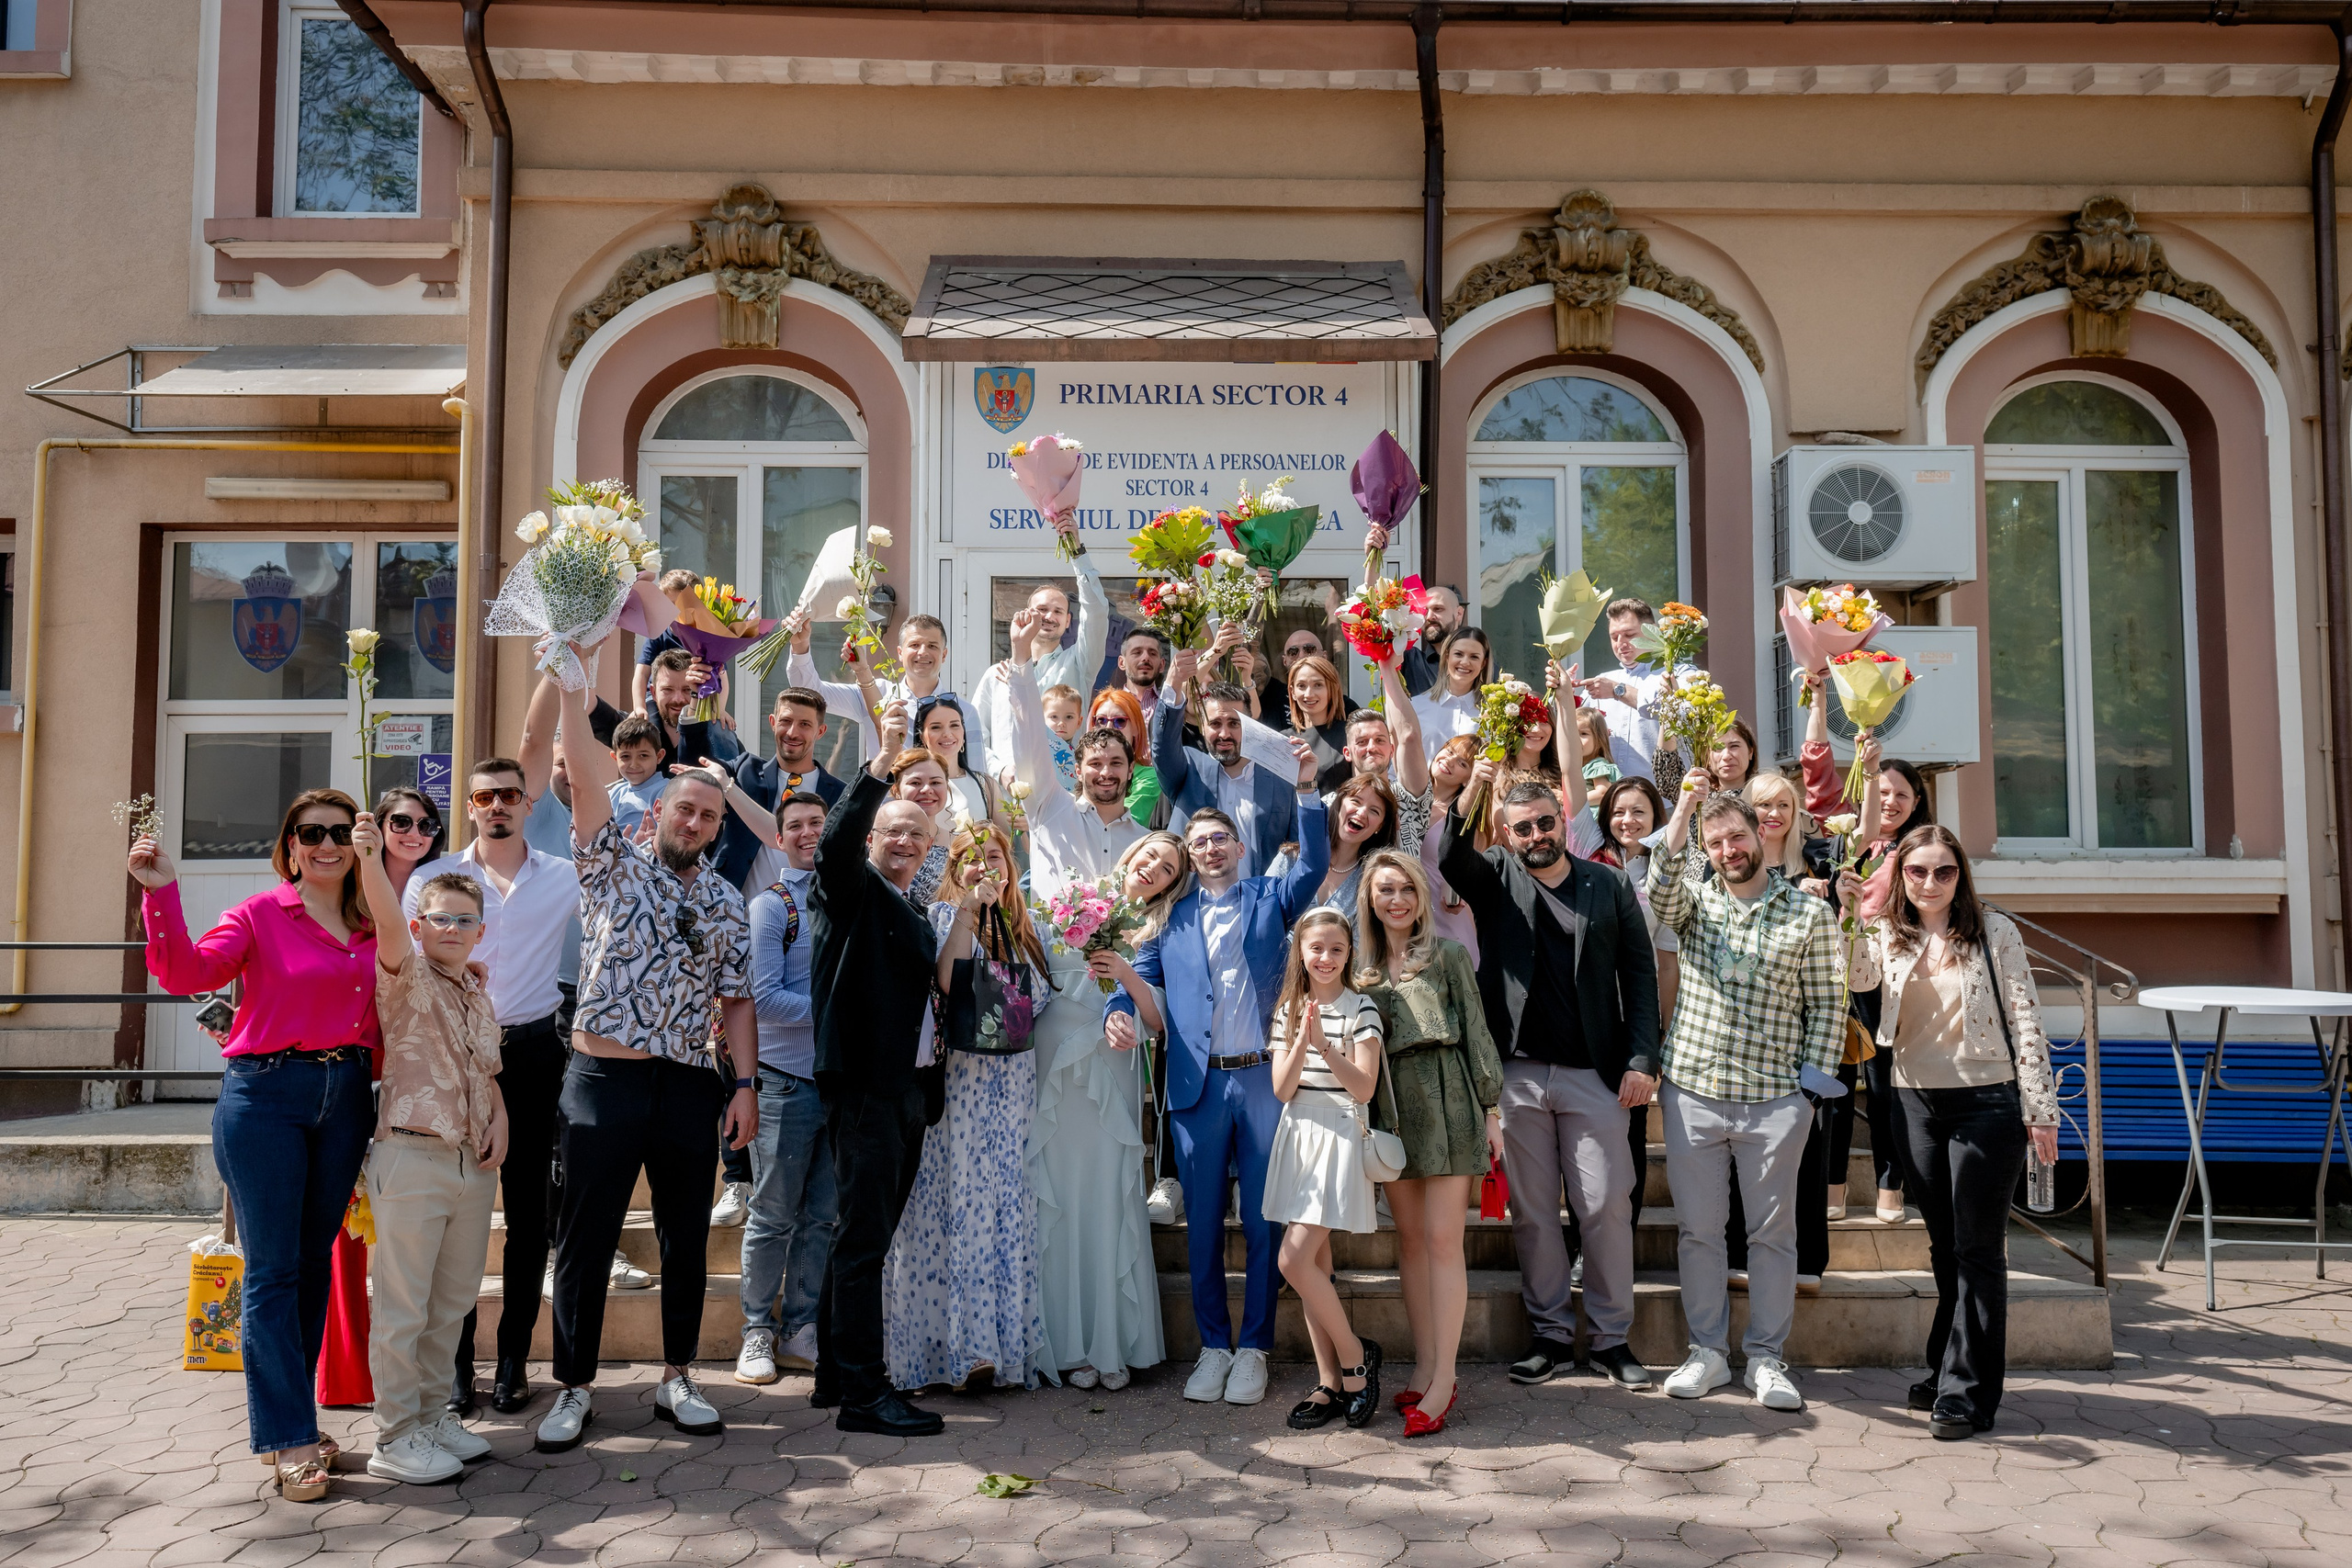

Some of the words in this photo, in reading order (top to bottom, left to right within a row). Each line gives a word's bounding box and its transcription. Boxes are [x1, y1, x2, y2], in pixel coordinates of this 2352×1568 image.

[1059, 383, 1204, 404] PRIMARIA
[1213, 384, 1327, 405] SECTOR
[1334, 387, 1348, 405] 4
[1107, 452, 1198, 470] EVIDENTA
[1204, 453, 1216, 470] A
[1220, 453, 1347, 471] PERSOANELOR
[1125, 479, 1196, 496] SECTOR
[1200, 480, 1209, 496] 4
[989, 508, 1120, 530] SERVIUL
